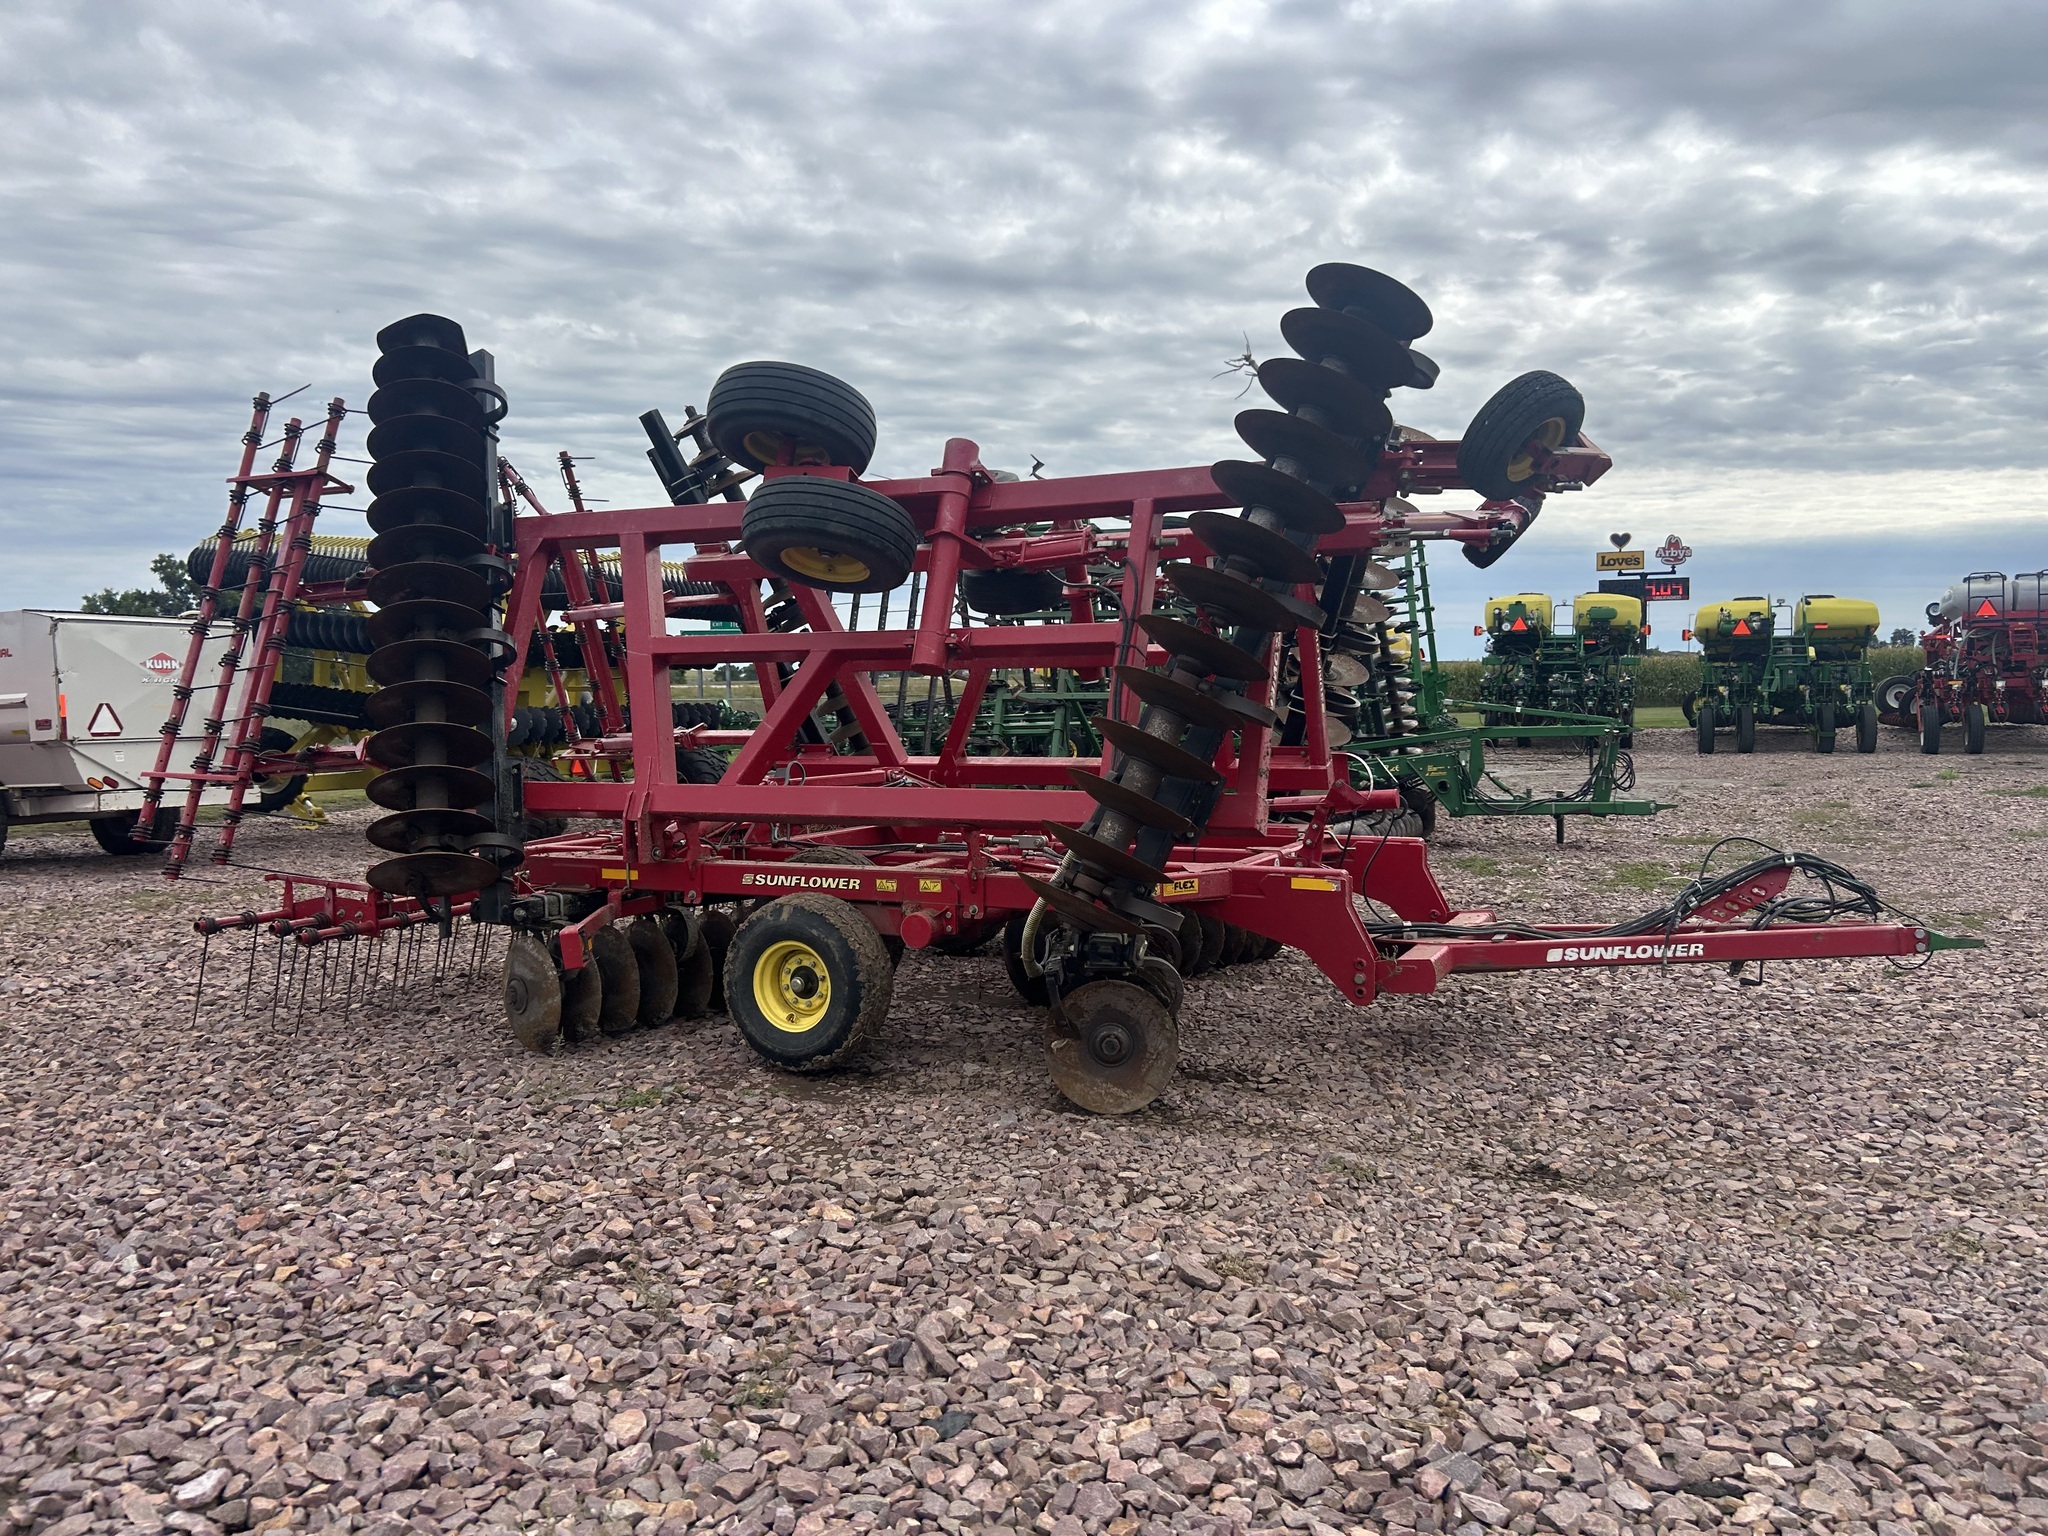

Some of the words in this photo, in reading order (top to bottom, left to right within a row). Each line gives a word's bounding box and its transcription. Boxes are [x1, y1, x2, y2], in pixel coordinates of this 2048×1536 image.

[1656, 546, 1692, 558] Arby's
[146, 659, 179, 670] KUHN
[755, 874, 861, 890] SUNFLOWER
[1564, 944, 1704, 961] SUNFLOWER
